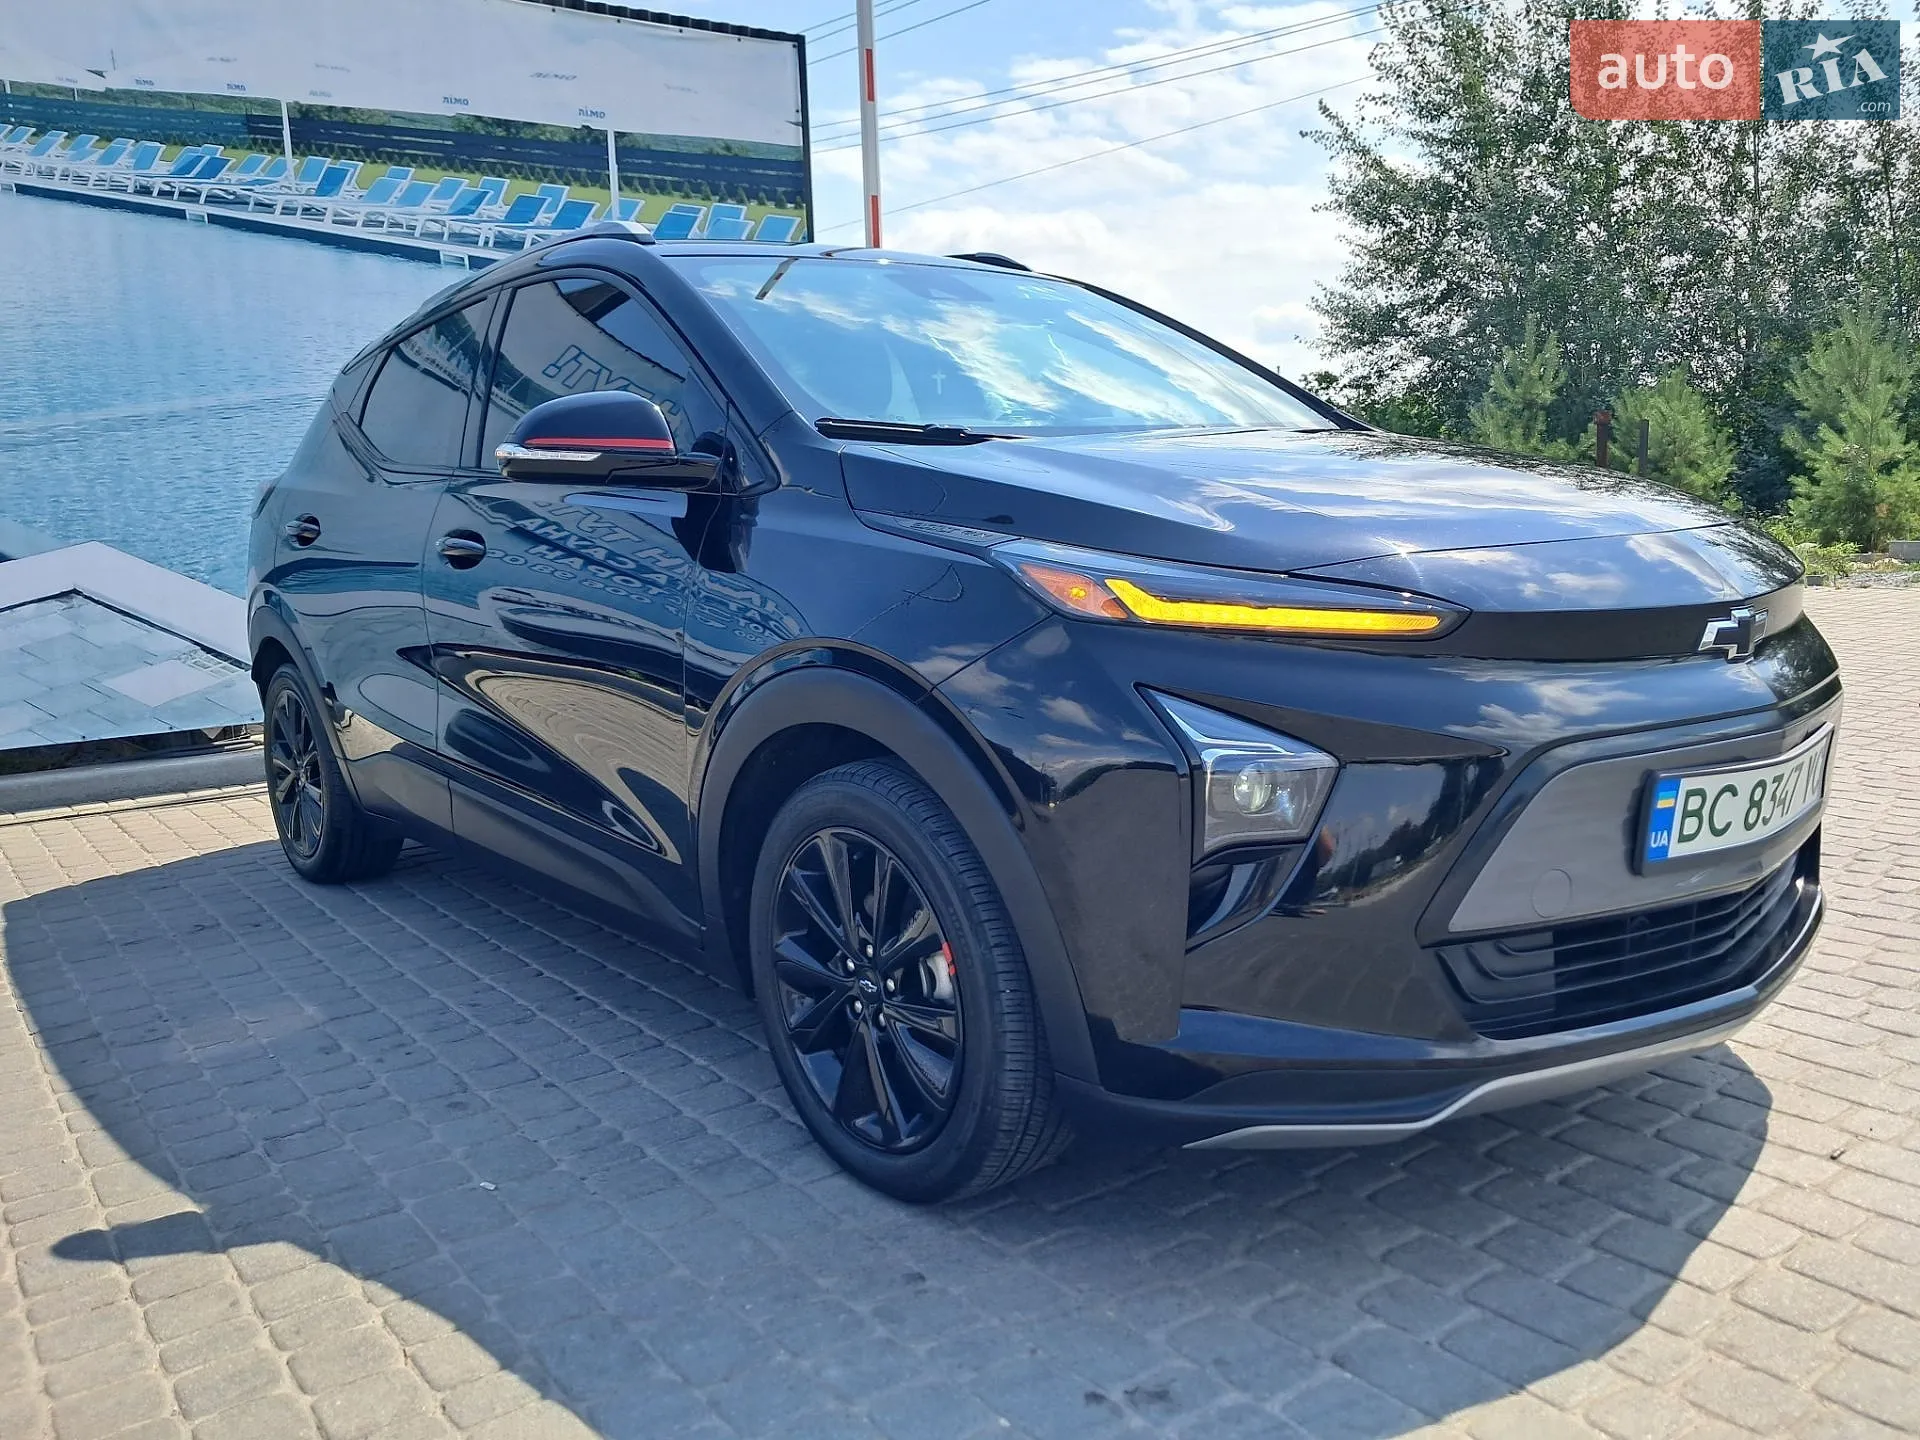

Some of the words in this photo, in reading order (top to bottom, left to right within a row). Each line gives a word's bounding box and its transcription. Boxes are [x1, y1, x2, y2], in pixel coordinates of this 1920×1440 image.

[1677, 783, 1739, 844] BC
[1743, 761, 1804, 831] 8347
[1651, 830, 1669, 848] UA
